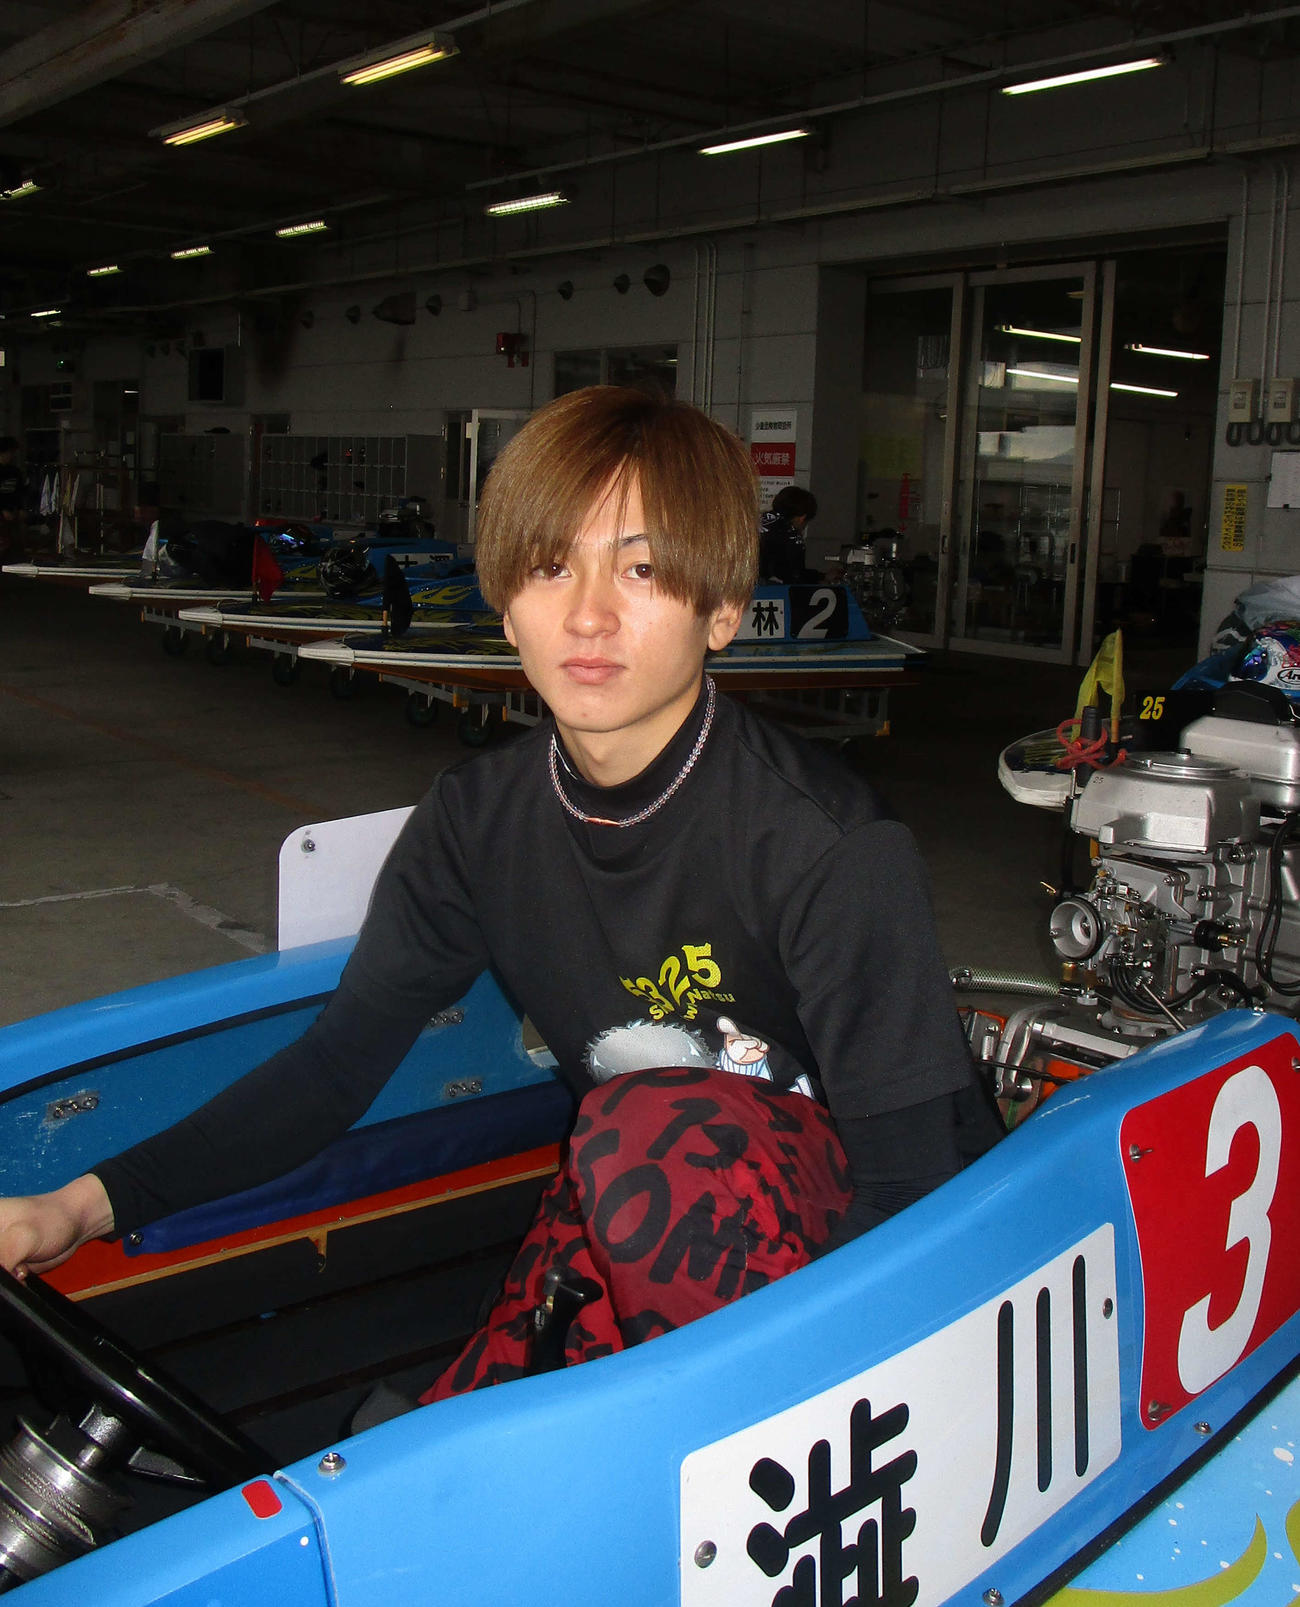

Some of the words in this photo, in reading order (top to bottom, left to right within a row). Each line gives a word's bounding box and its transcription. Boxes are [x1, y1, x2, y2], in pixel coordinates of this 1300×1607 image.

[752, 601, 779, 637] 林
[796, 588, 838, 639] 2
[1140, 696, 1165, 720] 25
[1177, 1066, 1283, 1394] 3
